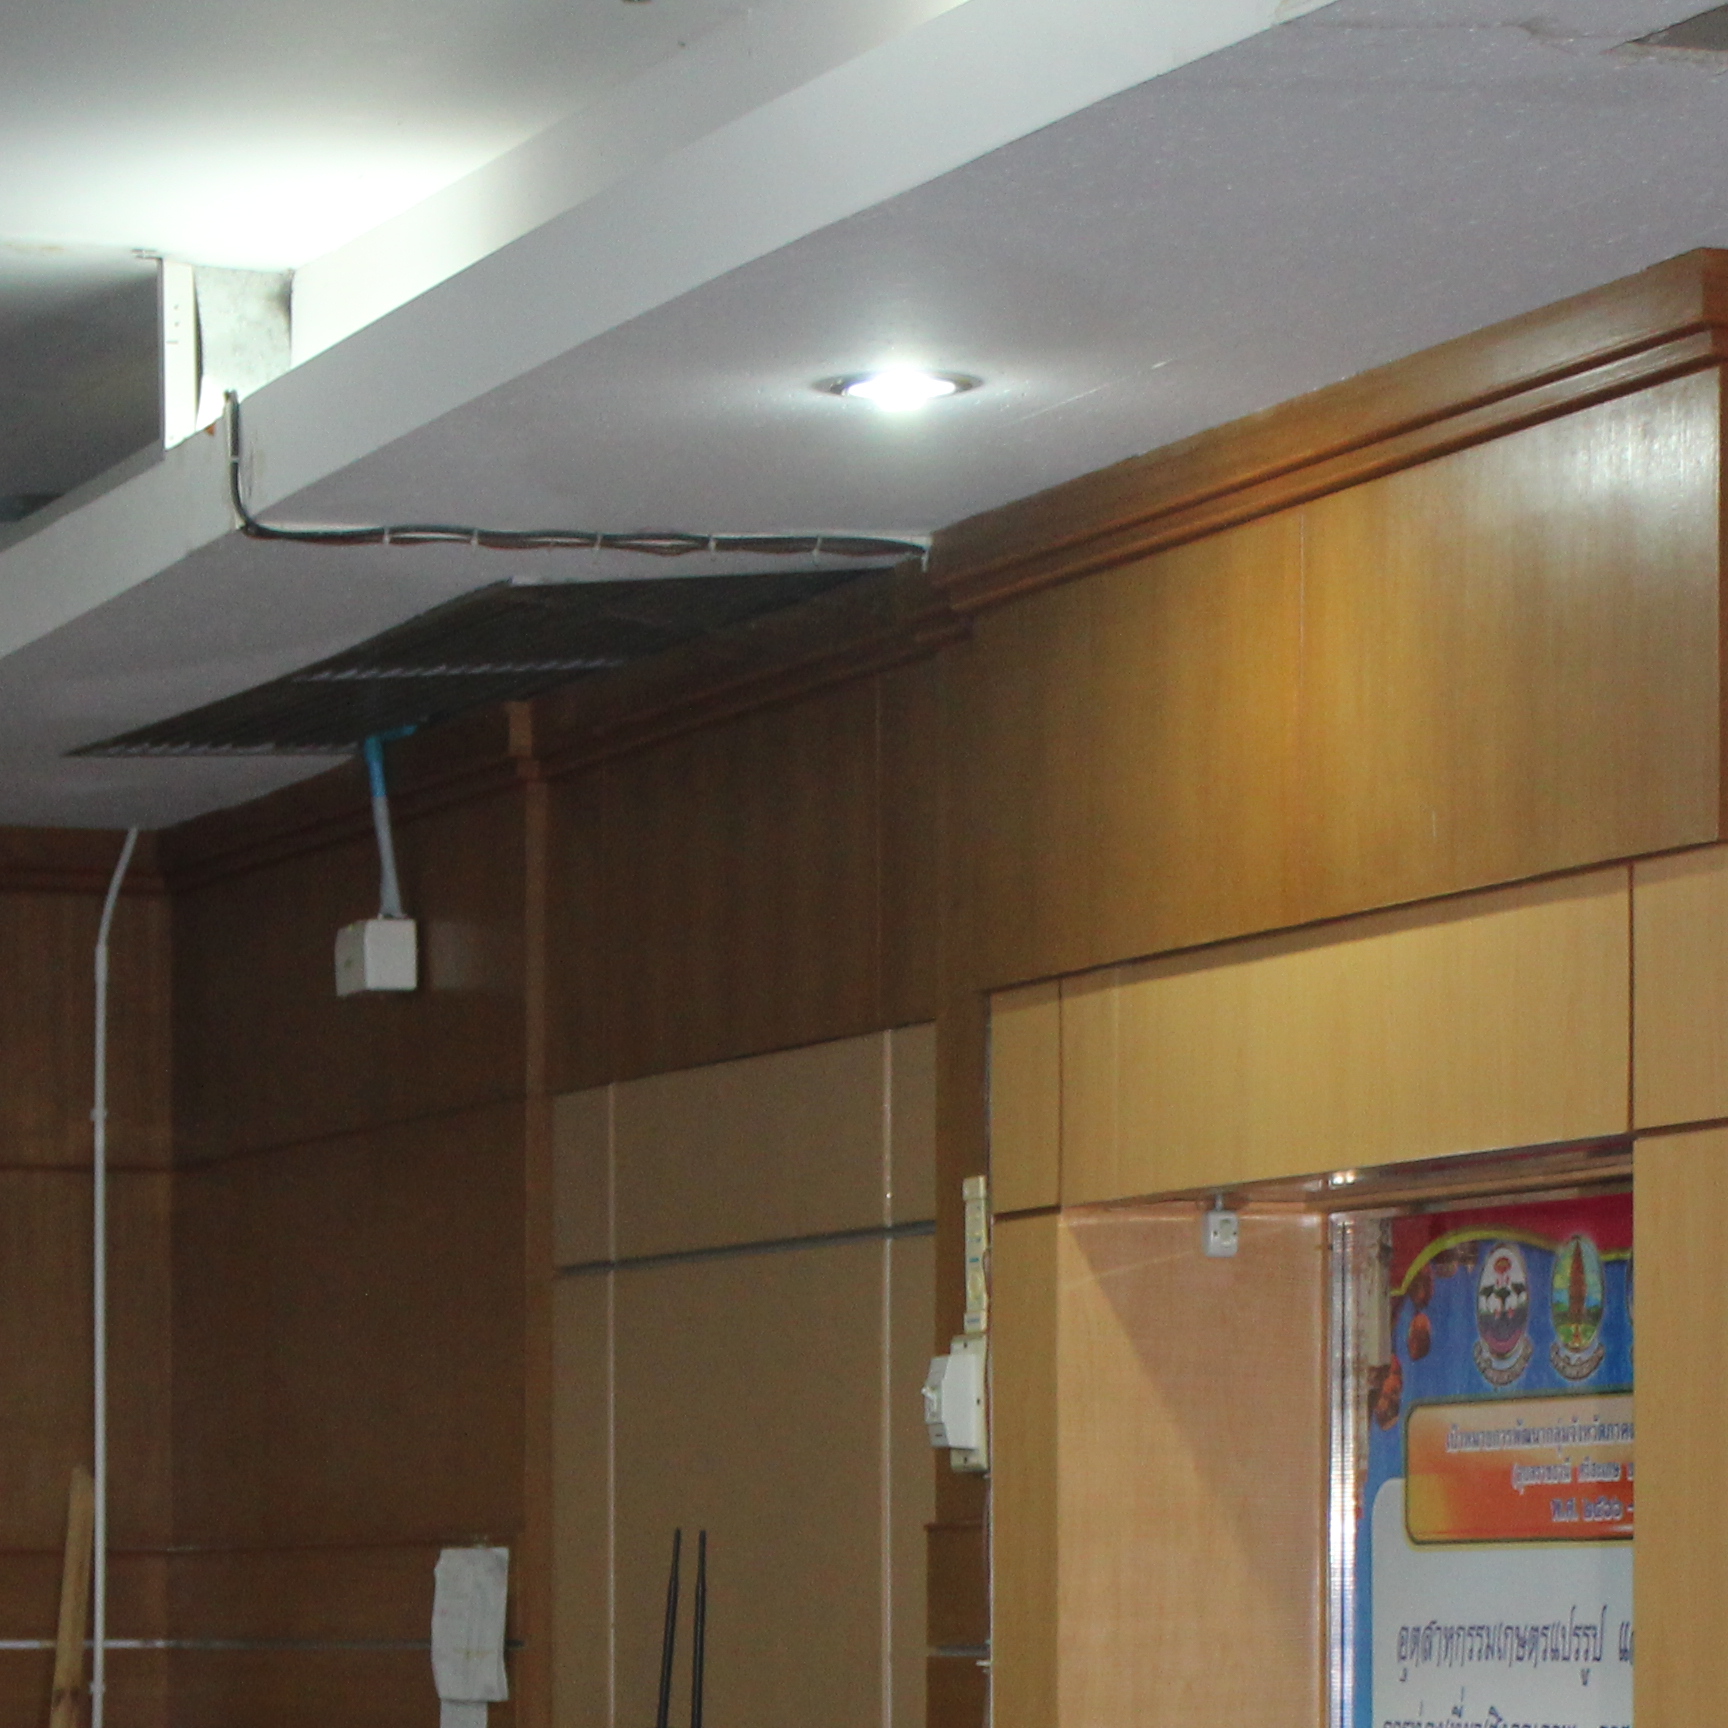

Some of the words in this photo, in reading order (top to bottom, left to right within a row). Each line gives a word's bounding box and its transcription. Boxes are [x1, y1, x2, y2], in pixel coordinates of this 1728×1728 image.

[1395, 1603, 1608, 1687] อุตสาหกรรมเกษตรแปรรูป
